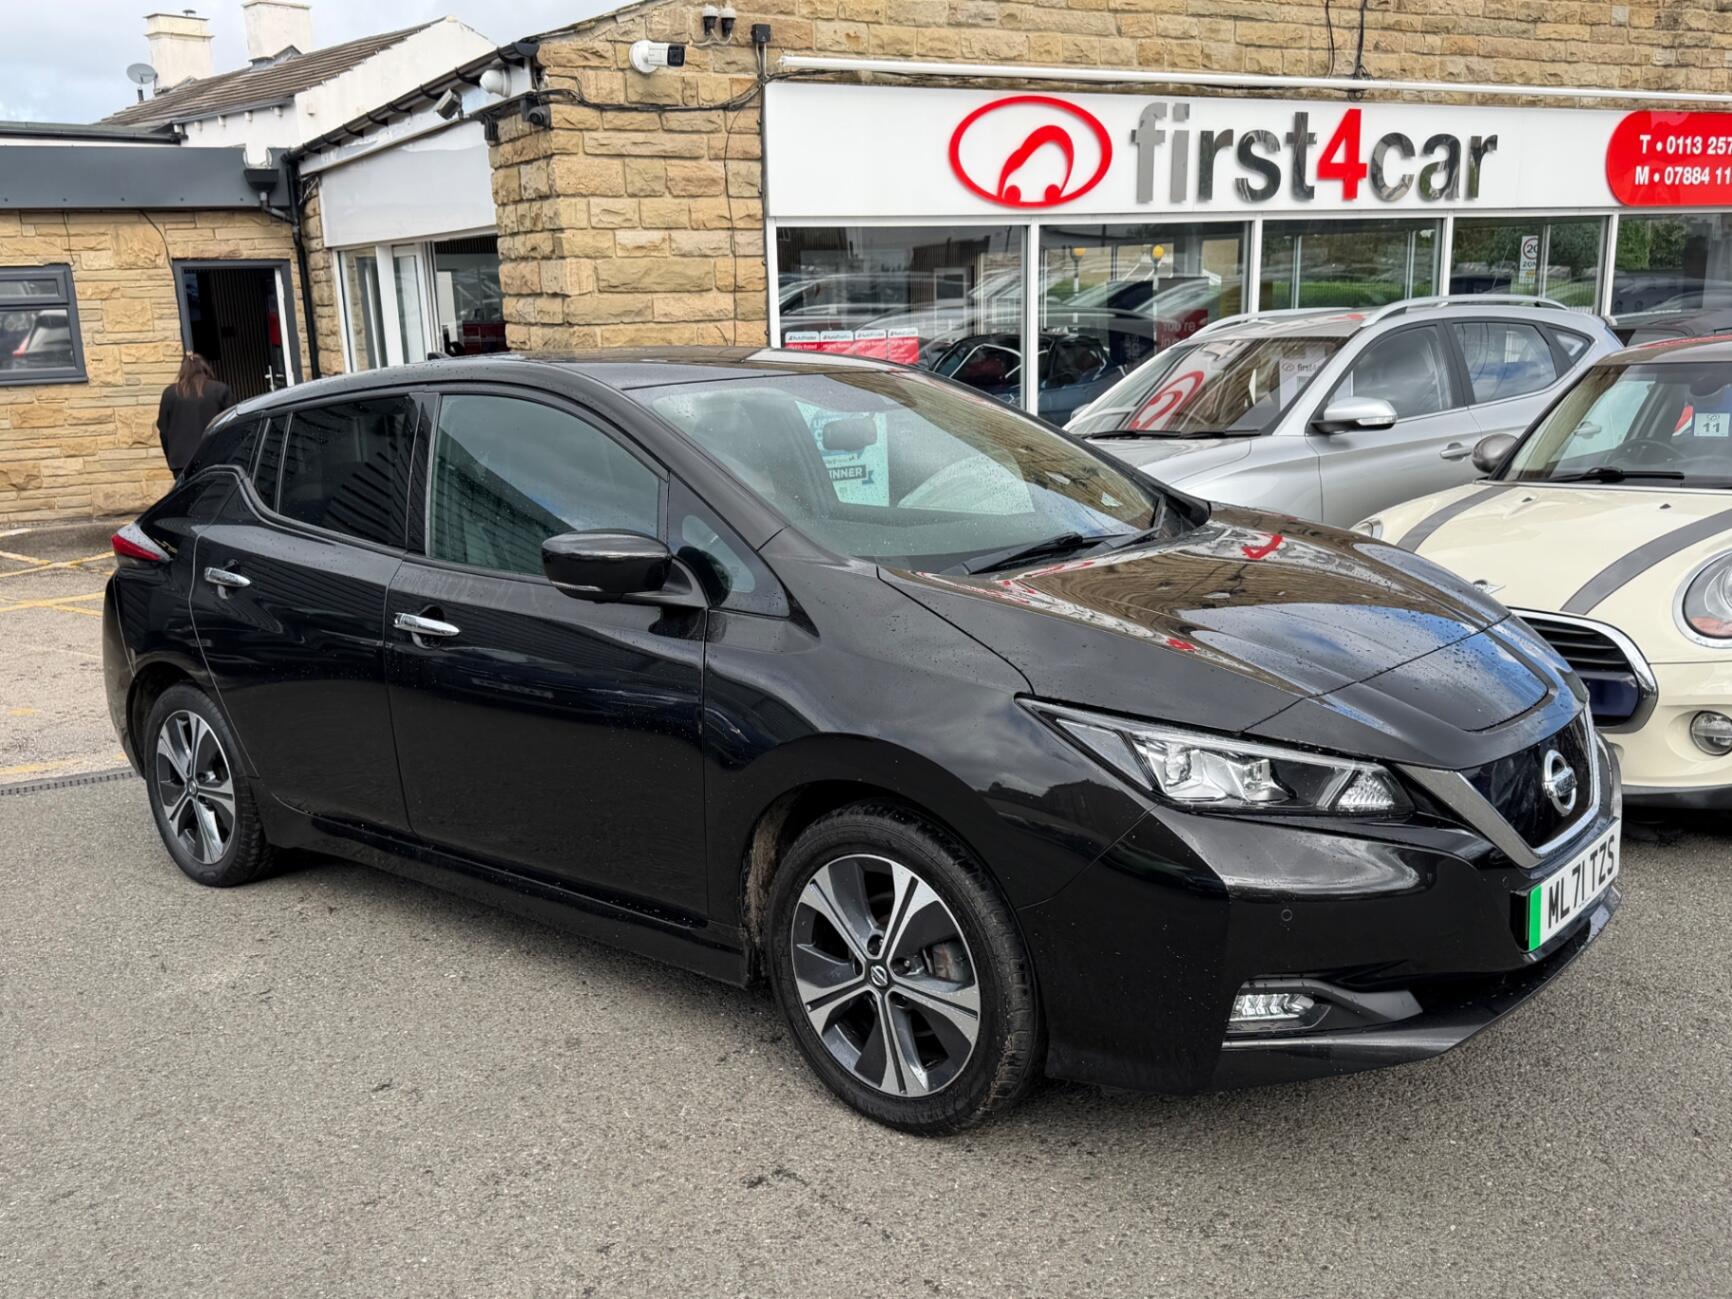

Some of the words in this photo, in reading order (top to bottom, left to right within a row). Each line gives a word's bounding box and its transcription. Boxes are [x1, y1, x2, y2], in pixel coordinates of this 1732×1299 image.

[1130, 101, 1499, 204] first4car
[1640, 134, 1651, 154] T
[1666, 135, 1703, 155] 0113
[1635, 166, 1650, 185] M
[1664, 166, 1710, 186] 07884
[1715, 166, 1732, 186] 11
[828, 467, 863, 480] INNER
[1548, 859, 1585, 929] ML71
[1589, 834, 1615, 893] TZS
